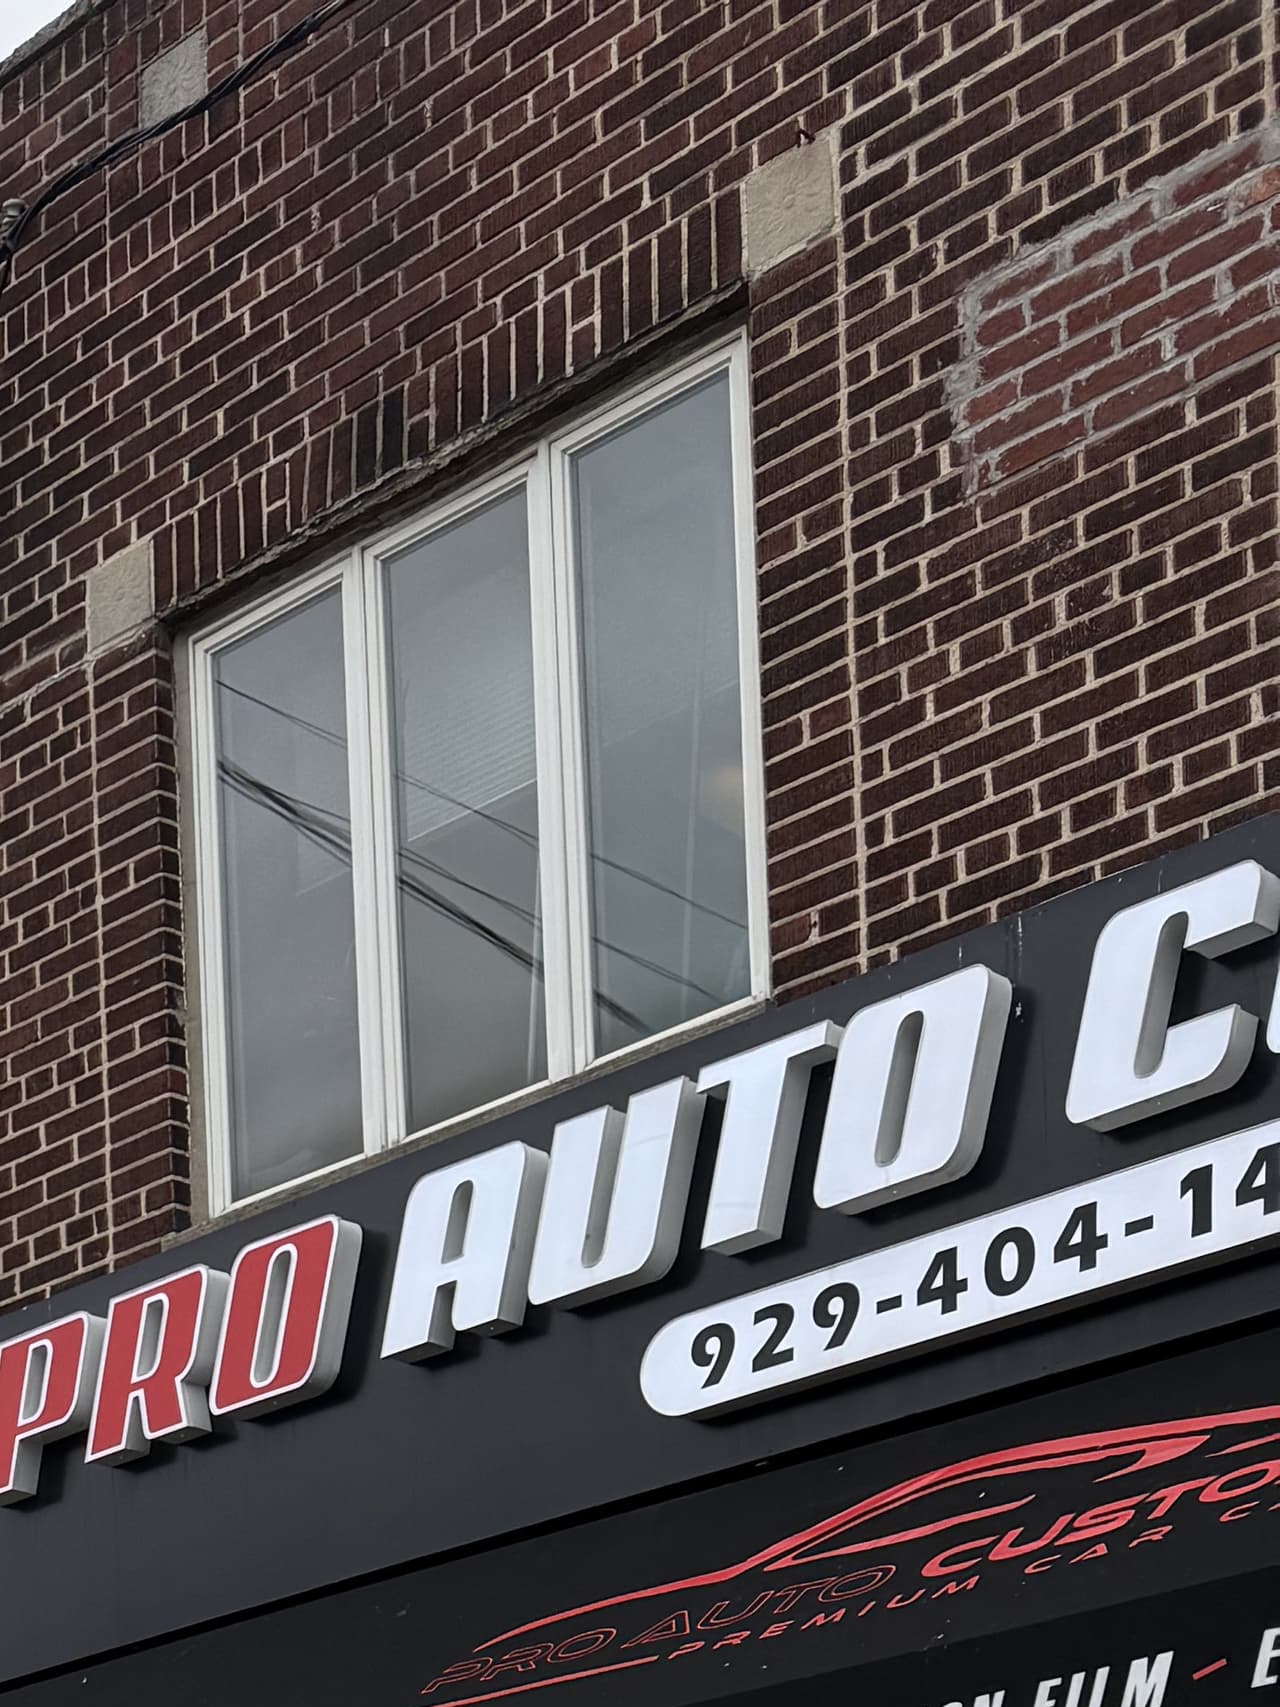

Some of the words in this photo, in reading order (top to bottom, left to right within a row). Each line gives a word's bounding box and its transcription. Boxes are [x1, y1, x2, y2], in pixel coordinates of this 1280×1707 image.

[380, 963, 1012, 1362] AUTO
[421, 1628, 616, 1695] PRO
[621, 1565, 896, 1648] AUTO
[921, 1459, 1280, 1577] CUSTO
[668, 1575, 980, 1660] PREMIUM
[1024, 1525, 1173, 1574] CAR
